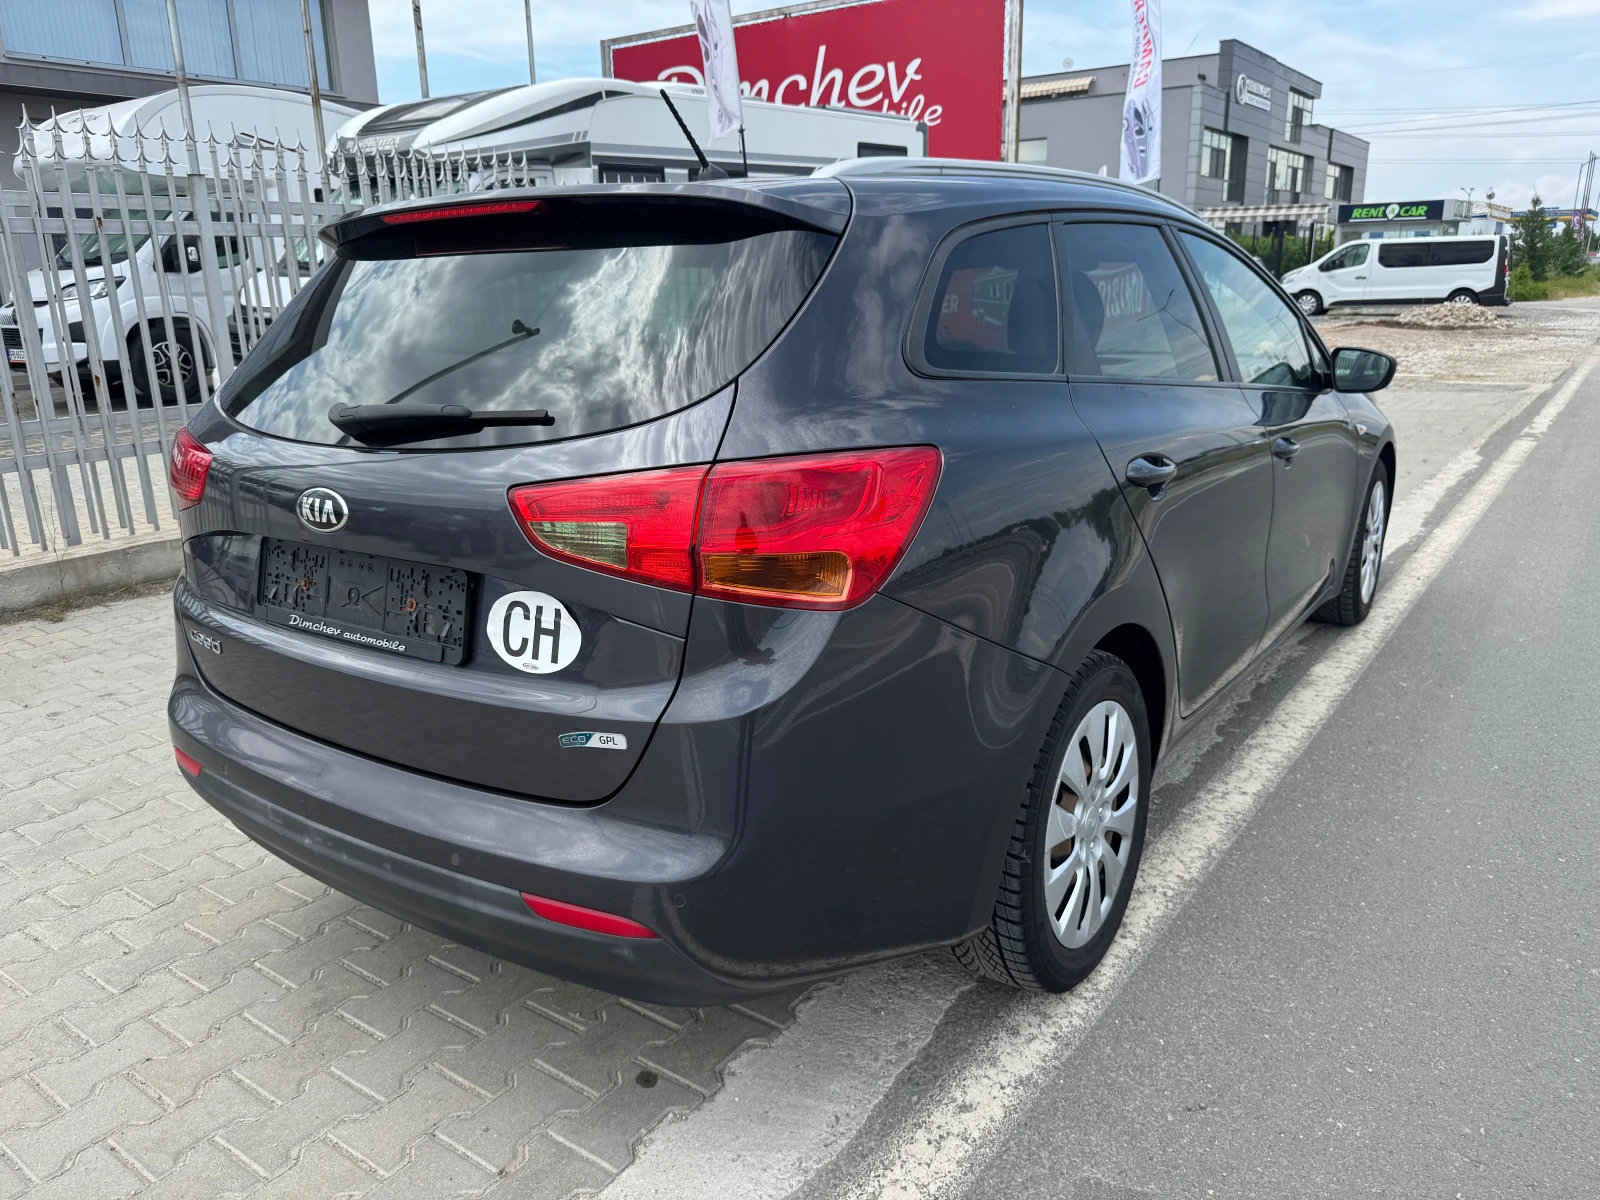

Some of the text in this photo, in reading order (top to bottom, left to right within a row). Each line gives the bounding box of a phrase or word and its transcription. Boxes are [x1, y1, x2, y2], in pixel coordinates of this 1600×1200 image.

[1400, 205, 1428, 216] CAR
[302, 496, 338, 524] KIA
[289, 614, 406, 652] Dimchev automobile
[503, 600, 561, 664] CH
[562, 735, 619, 746] ECO GPL
